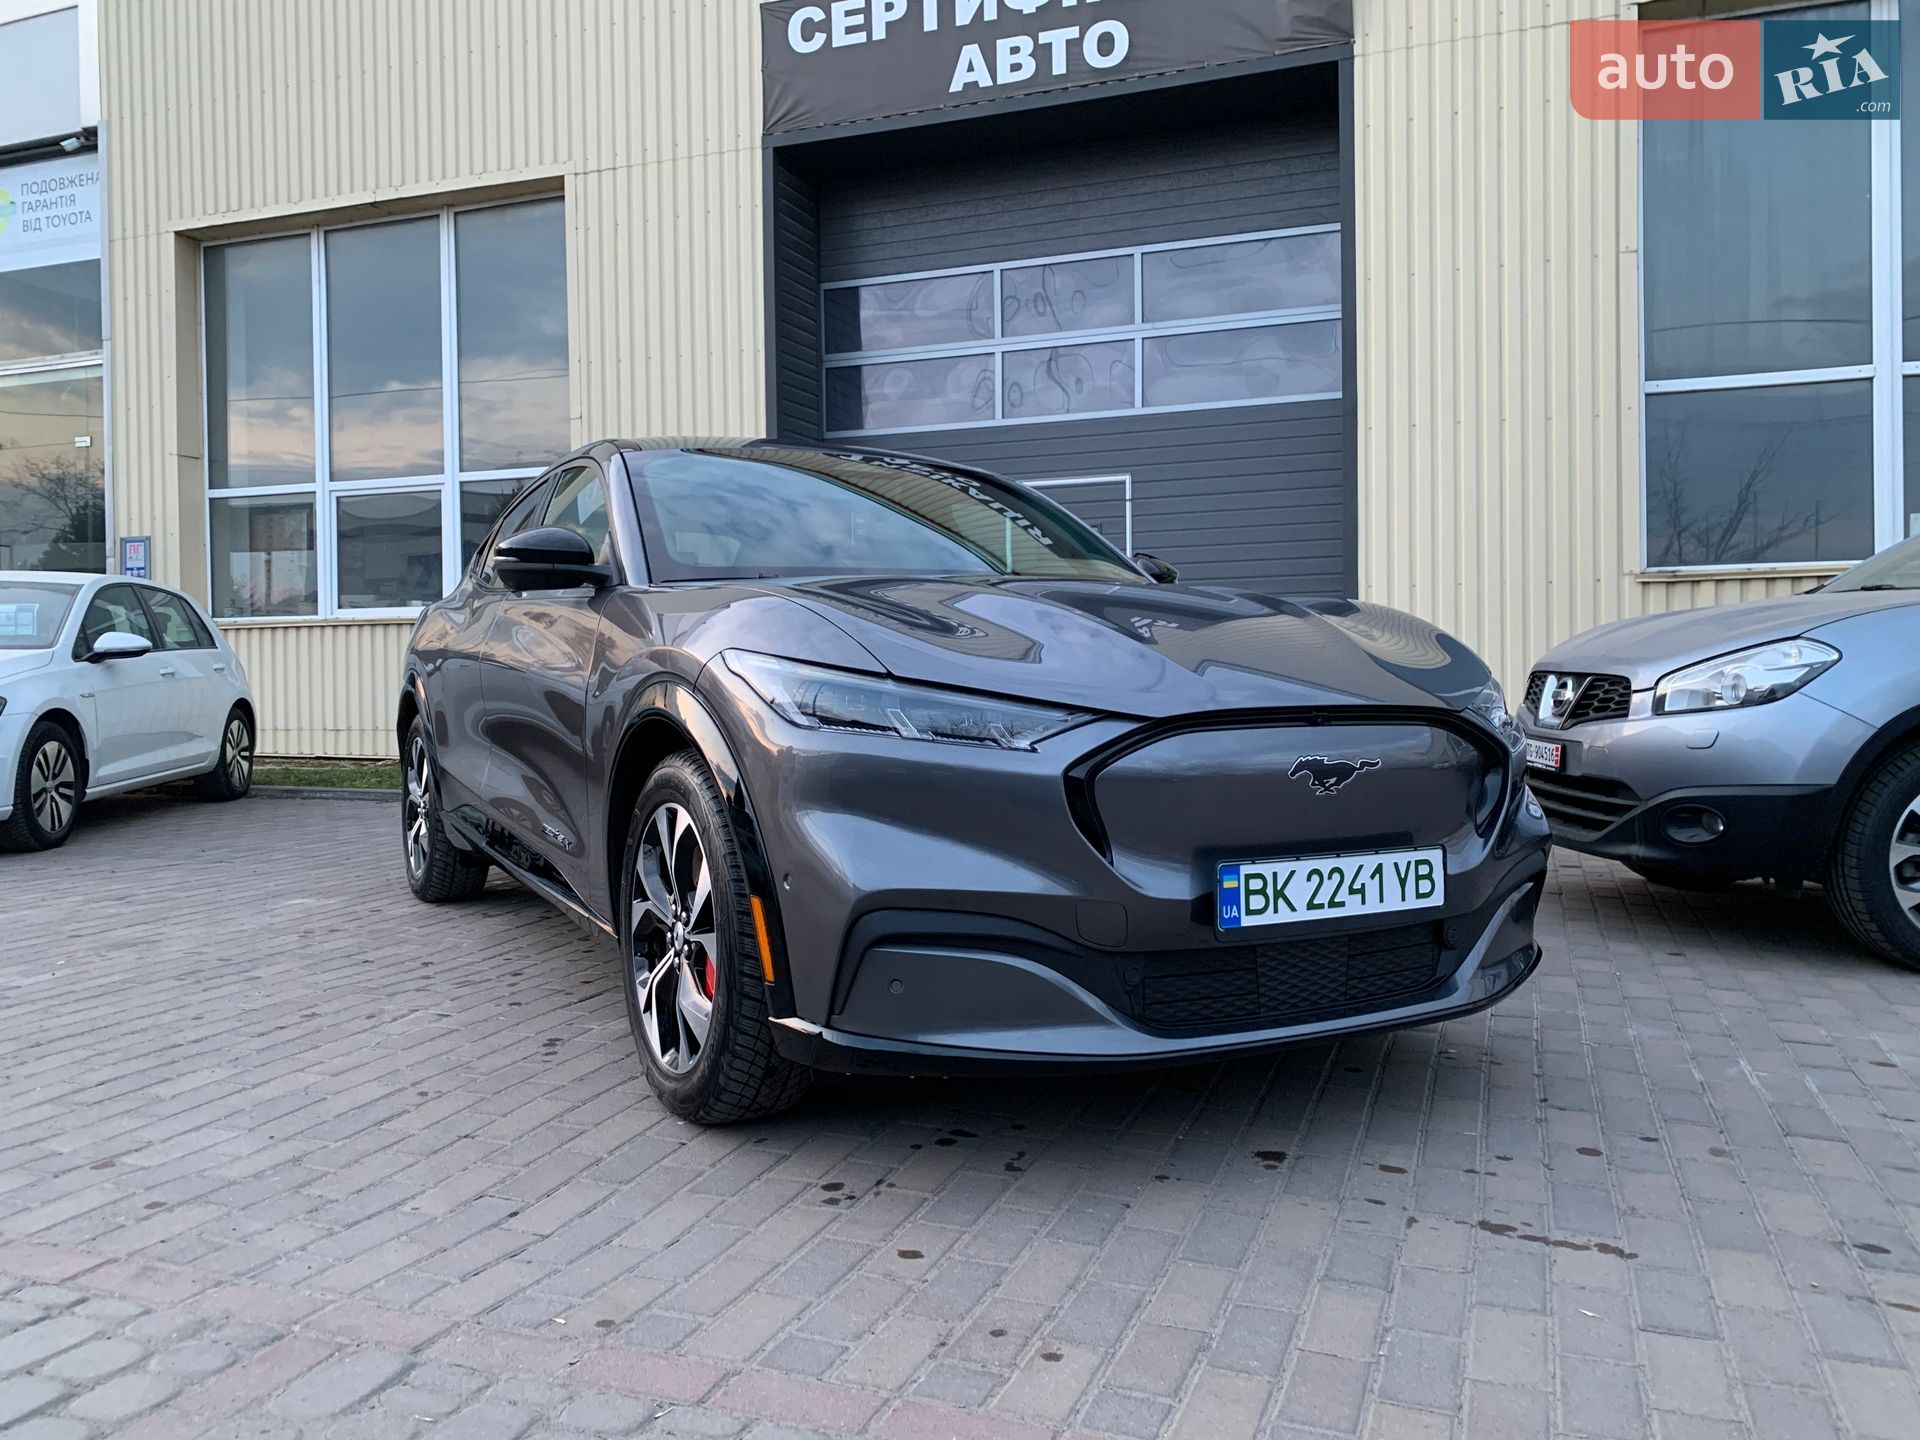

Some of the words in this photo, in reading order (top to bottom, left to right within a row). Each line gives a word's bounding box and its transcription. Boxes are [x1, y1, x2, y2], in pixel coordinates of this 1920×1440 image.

[788, 0, 1101, 54] СЕРТИ
[949, 20, 1129, 92] АВТО
[21, 193, 76, 214] ГАРАНТІЯ
[22, 217, 42, 233] ВІД
[44, 210, 93, 229] TOYOTA
[1244, 870, 1297, 916] BK
[1306, 862, 1384, 911] 2241
[1393, 858, 1436, 902] YB
[1223, 904, 1239, 918] UA
